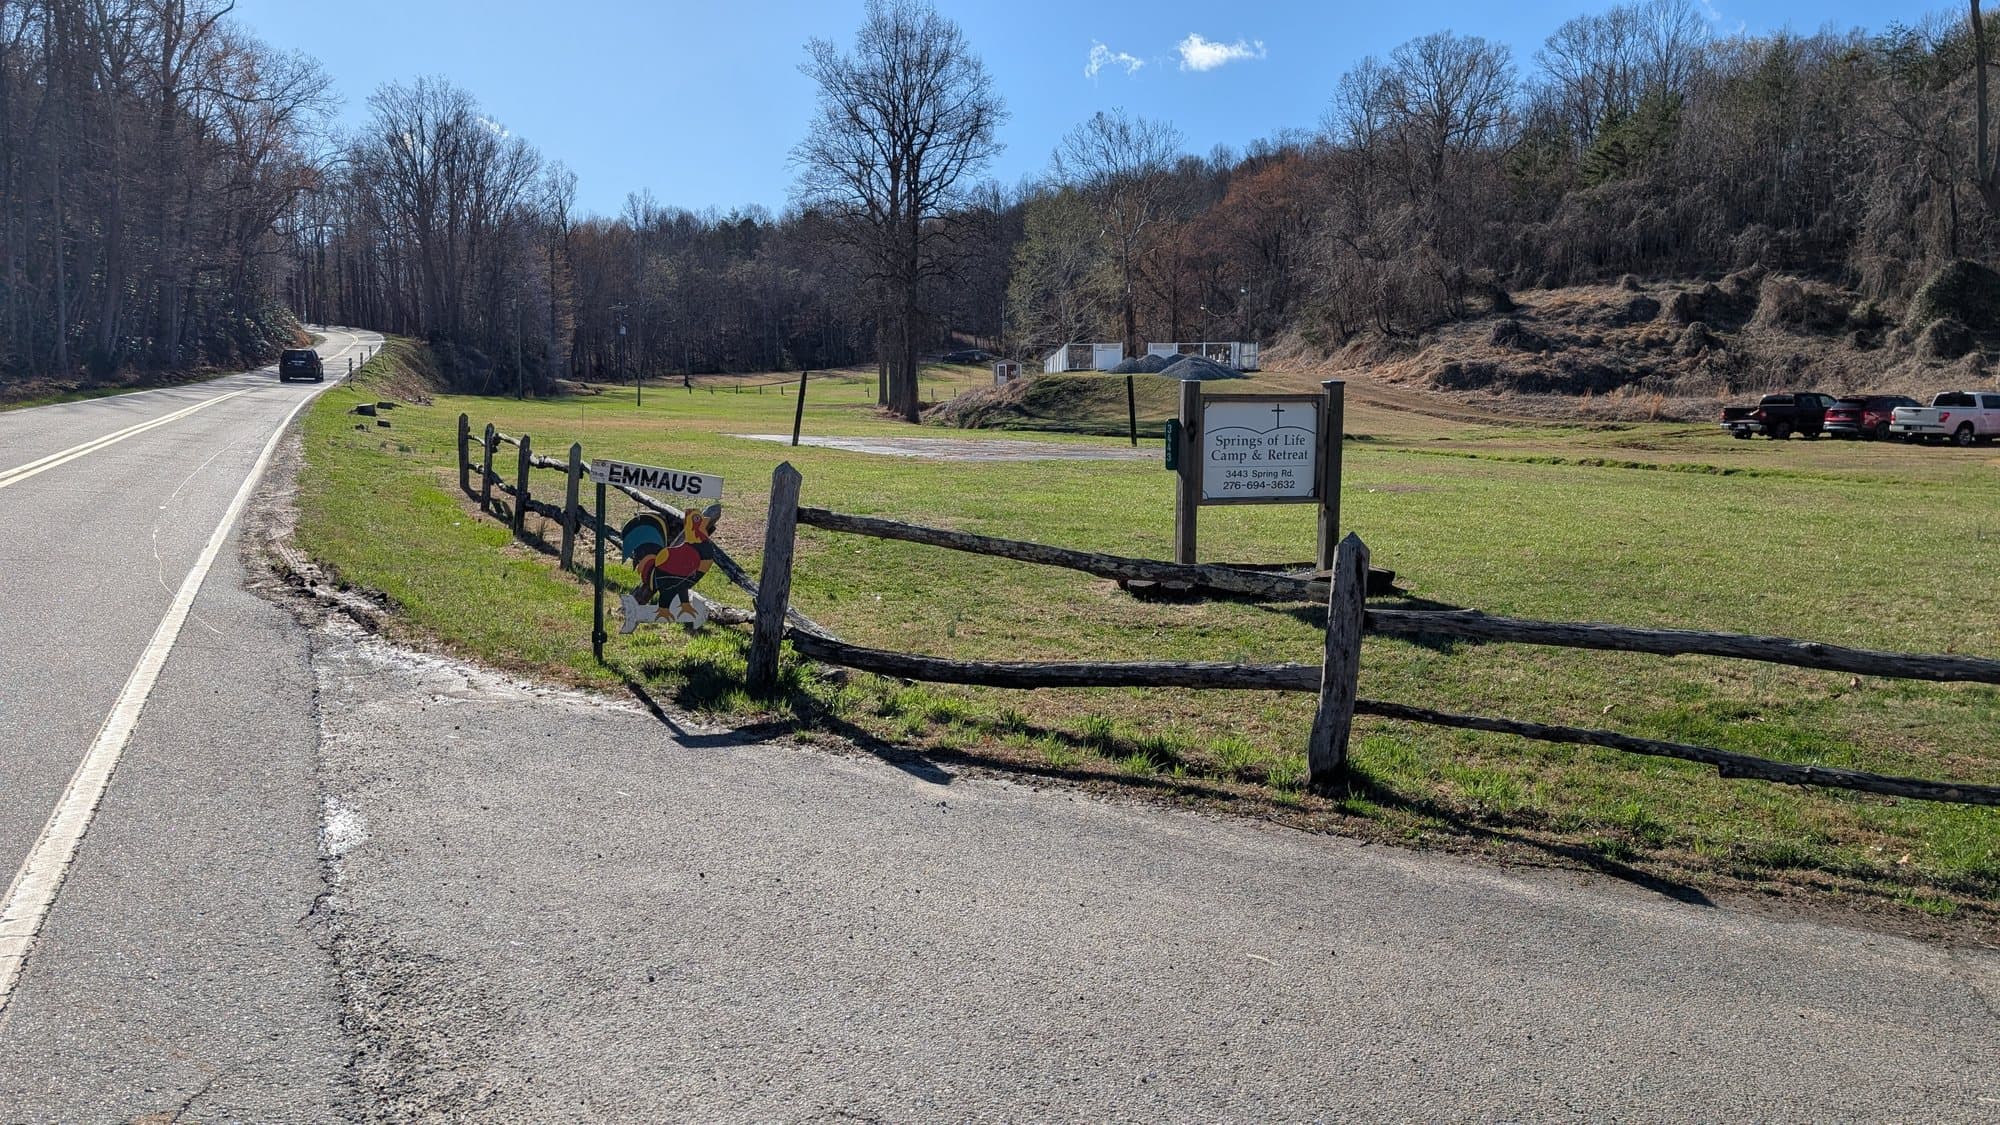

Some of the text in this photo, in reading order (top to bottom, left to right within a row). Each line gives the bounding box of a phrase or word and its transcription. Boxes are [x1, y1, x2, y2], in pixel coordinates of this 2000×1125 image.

[1215, 434, 1306, 449] Springs of Life
[1211, 449, 1308, 463] Camp & Retreat
[608, 464, 702, 494] EMMAUS
[1225, 469, 1294, 479] 3443 Spring Rd.
[1223, 480, 1295, 490] 276-694-3632
